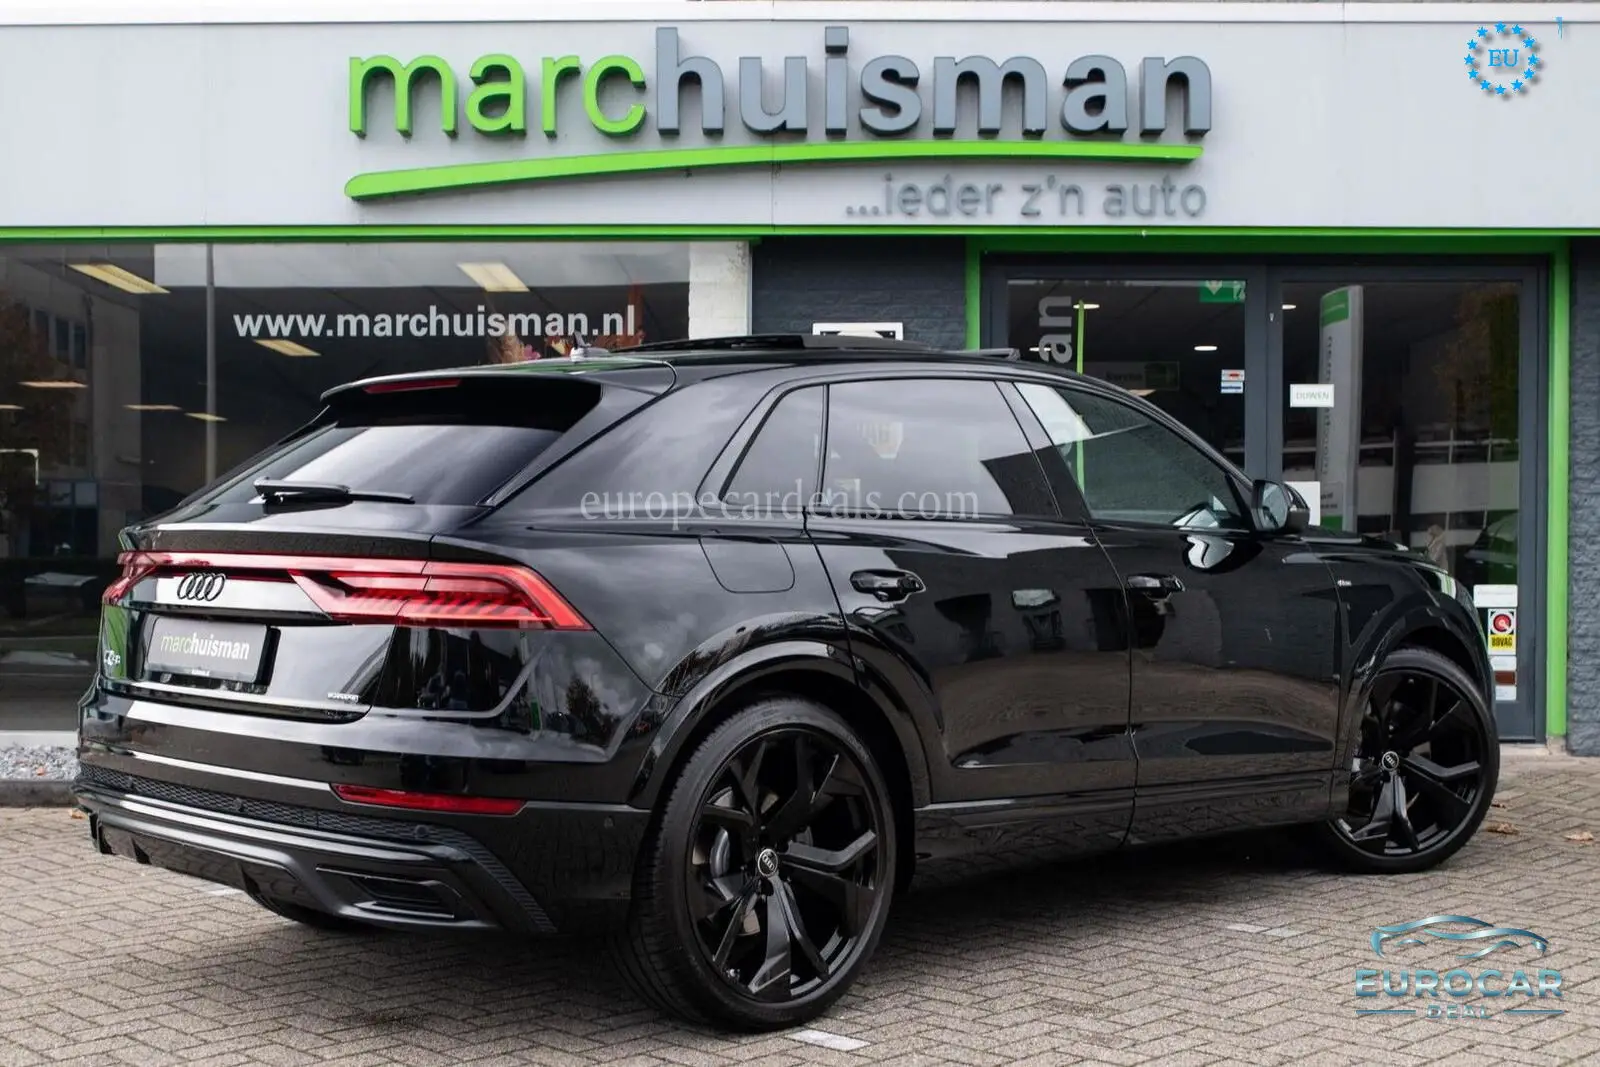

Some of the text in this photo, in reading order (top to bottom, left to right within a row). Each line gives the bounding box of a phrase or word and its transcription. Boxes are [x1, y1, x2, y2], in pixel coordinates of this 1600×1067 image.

[348, 26, 1212, 138] marchuisman
[1020, 174, 1084, 217] z'n
[1103, 174, 1207, 217] auto
[233, 304, 635, 337] www.marchuisman.nl
[160, 632, 250, 661] marchuisman
